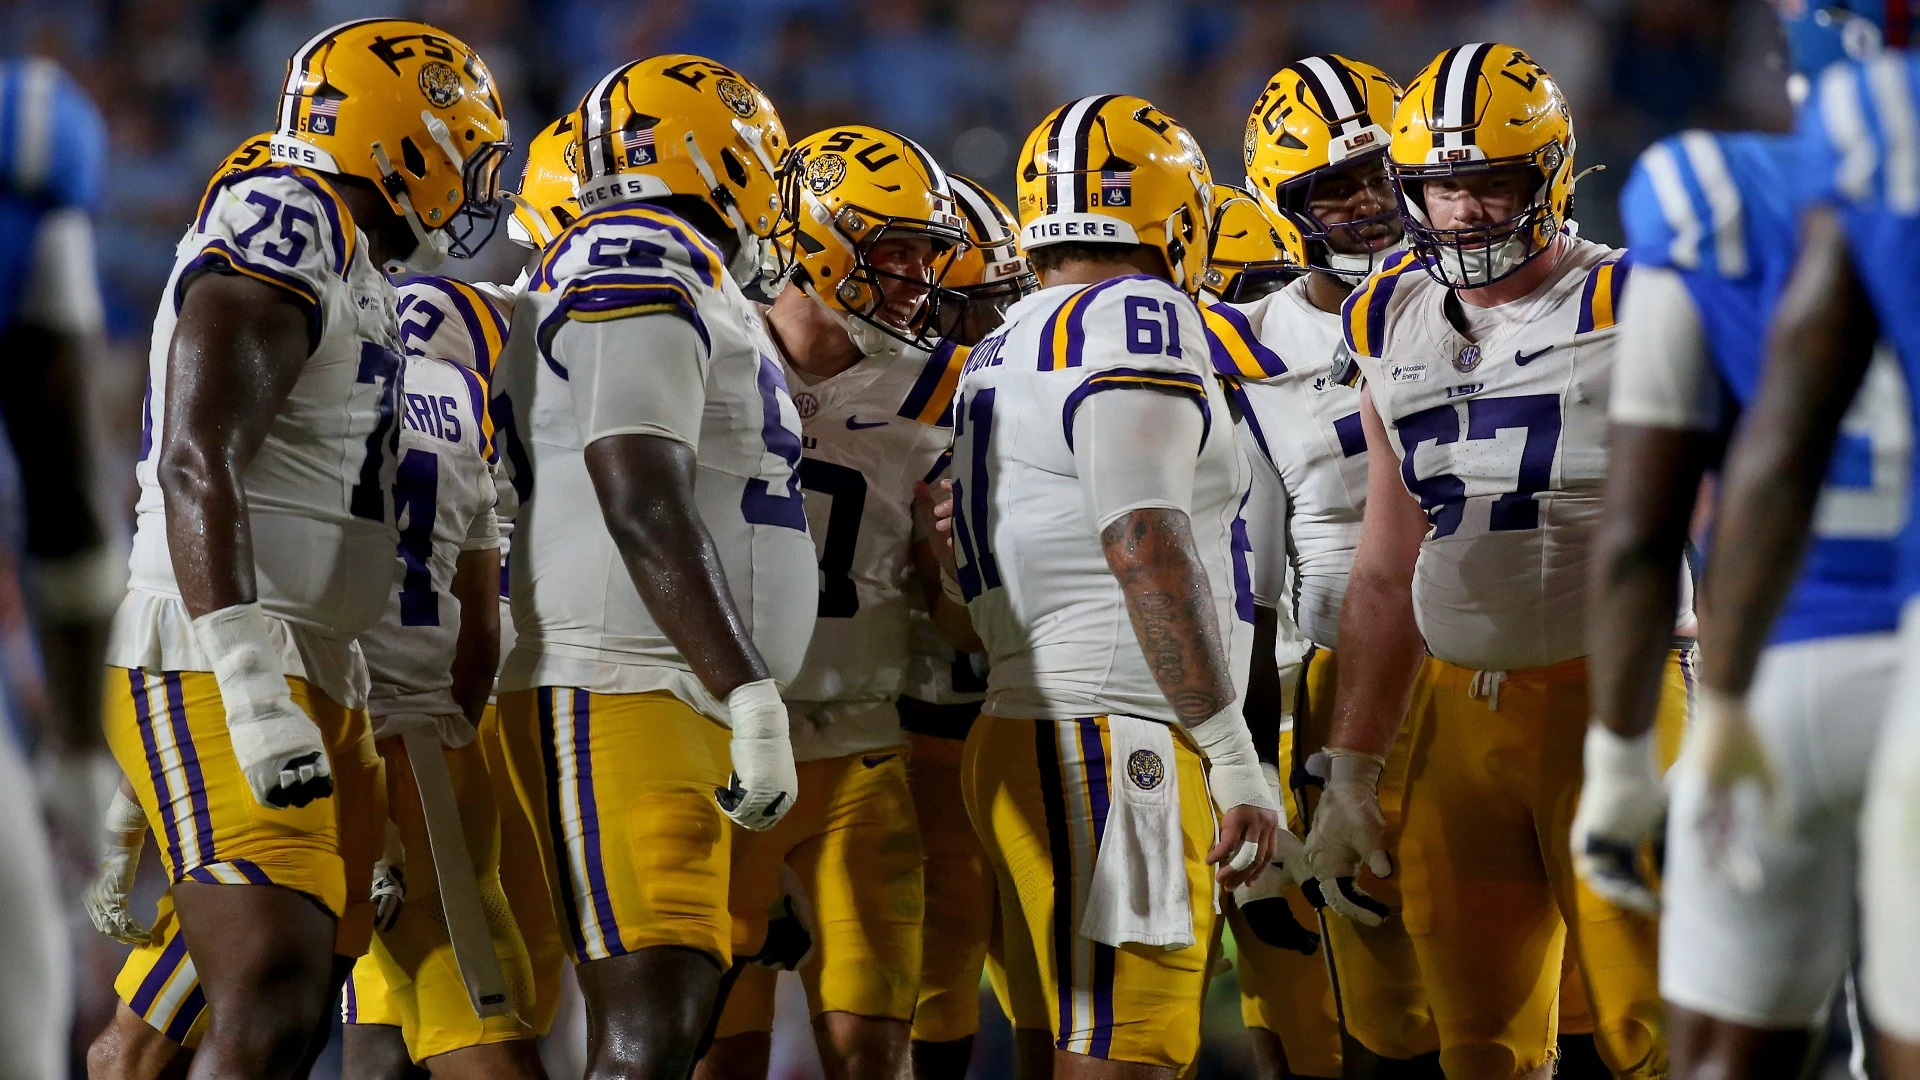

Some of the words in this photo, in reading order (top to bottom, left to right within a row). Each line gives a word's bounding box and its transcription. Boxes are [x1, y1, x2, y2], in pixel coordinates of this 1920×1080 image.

[1252, 82, 1293, 135] SU
[270, 143, 315, 163] GERS
[1343, 131, 1375, 151] LSU
[1438, 149, 1471, 162] LSU
[237, 190, 316, 267] 75
[1029, 222, 1117, 239] TIGERS
[396, 294, 445, 356] 2
[961, 320, 1019, 382] OORE
[1124, 295, 1182, 359] 61
[1446, 383, 1484, 399] LSU
[351, 341, 407, 524] 7
[740, 352, 807, 533] 5
[1394, 394, 1562, 540] 67
